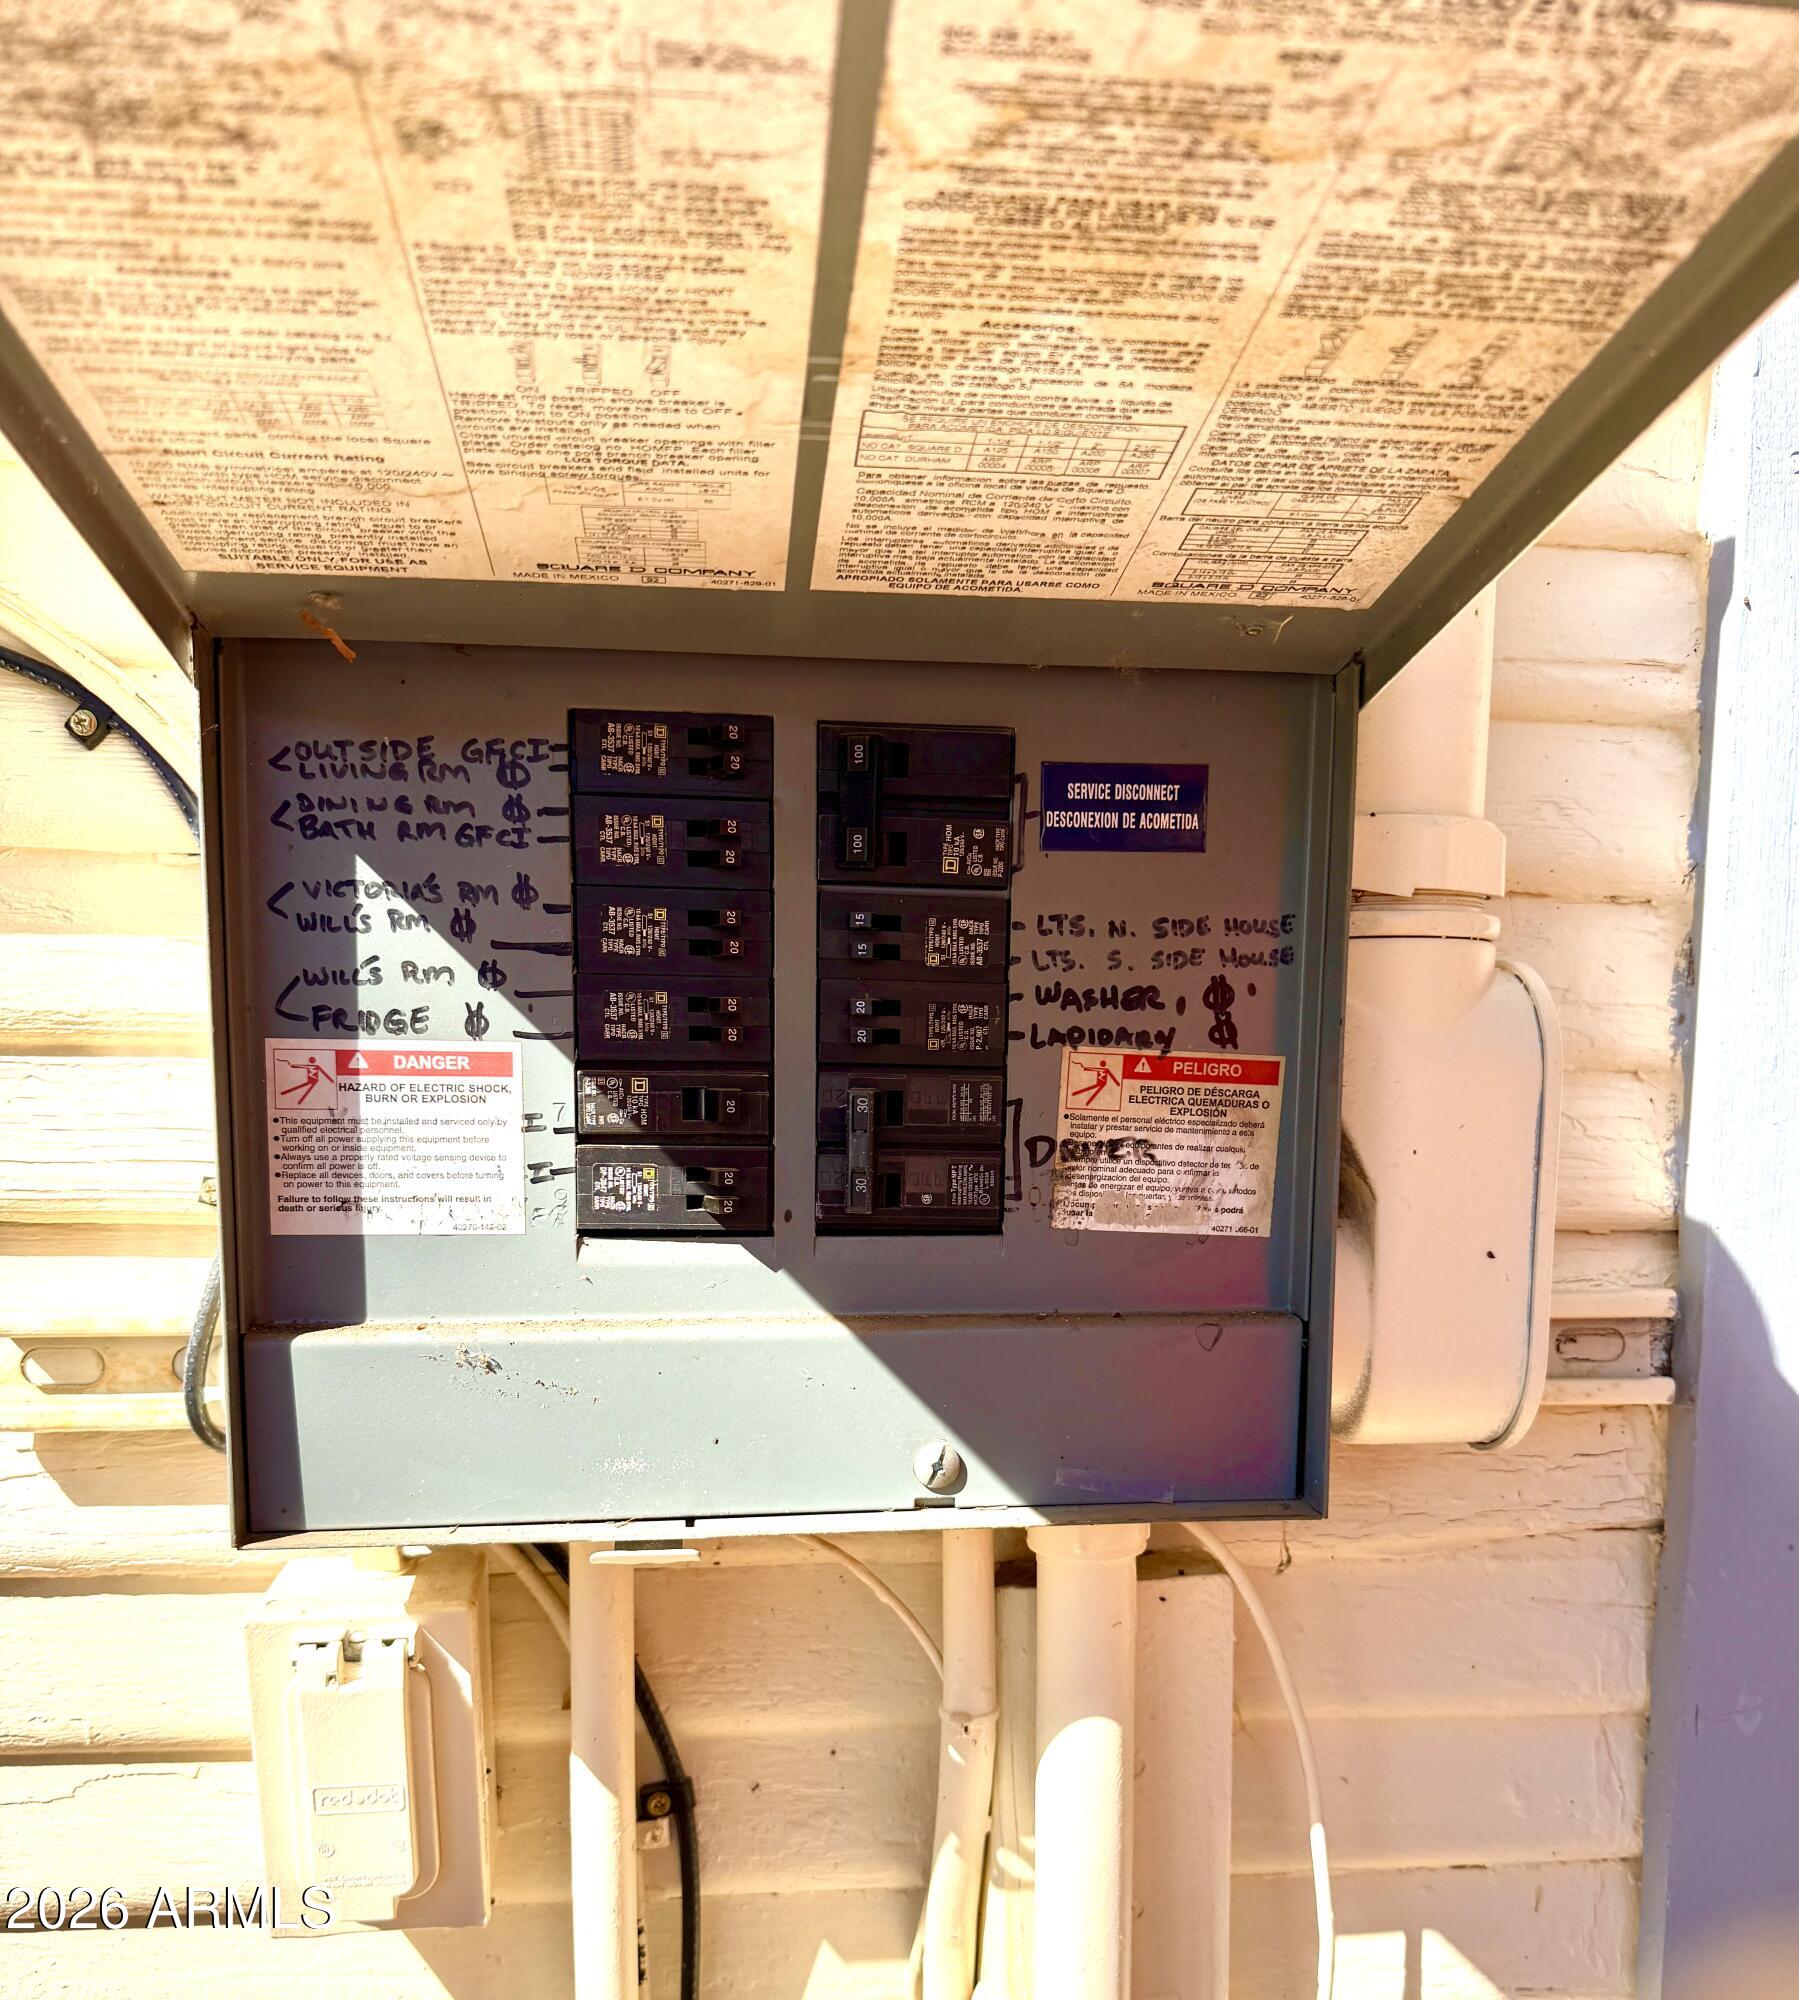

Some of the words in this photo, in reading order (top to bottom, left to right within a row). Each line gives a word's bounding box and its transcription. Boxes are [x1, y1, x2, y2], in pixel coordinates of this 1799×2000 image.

[219, 554, 293, 562] SUITABLE
[325, 565, 408, 573] EQUIPMENT
[655, 568, 756, 576] COMPANY
[953, 585, 1023, 593] ACOMETIDA.
[1152, 582, 1231, 590] SQUARE
[729, 725, 738, 739] 20
[295, 736, 434, 763] OUTSIDE
[462, 738, 549, 765] GFCI
[855, 744, 864, 763] 100
[731, 756, 739, 770] 20
[300, 762, 408, 782] LIVING
[418, 759, 470, 784] RM
[1067, 783, 1112, 800] SERVICE
[1115, 784, 1180, 801] DISCONNECT
[297, 793, 413, 814] DINING
[424, 795, 475, 818] RM
[728, 820, 737, 833] 20
[1046, 810, 1120, 829] DESCONEXION
[1123, 812, 1137, 829] DE
[1140, 812, 1199, 830] ACOMETIDA
[298, 814, 376, 841] BATH
[398, 822, 446, 842] RM
[455, 823, 531, 848] GFCI
[853, 835, 862, 853] 100
[726, 851, 735, 863] 20
[457, 881, 499, 907] RM
[297, 904, 371, 934] WILL'S
[387, 908, 432, 933] RM
[727, 912, 736, 924] 20
[855, 913, 864, 926] 15
[1152, 915, 1211, 939] SIDE
[1224, 914, 1295, 938] HOUSE
[730, 941, 738, 954] 20
[858, 943, 867, 956] 15
[1151, 948, 1205, 970] SIDE
[1219, 946, 1295, 969] HOUSE
[303, 955, 383, 986] WILL'S
[401, 961, 455, 986] RM
[728, 999, 737, 1011] 20
[856, 1001, 865, 1013] 20
[312, 1005, 429, 1035] FRIDGE
[728, 1029, 737, 1041] 20
[857, 1030, 866, 1043] 20
[394, 1055, 471, 1070] DANGER
[1173, 1062, 1242, 1077] PELIGRO
[339, 1083, 387, 1092] HAZARD
[391, 1084, 405, 1092] OF
[409, 1084, 465, 1092] ELECTRIC
[469, 1084, 512, 1094] SHOCK,
[1140, 1086, 1184, 1095] PELIGRO
[1187, 1087, 1201, 1095] DE
[365, 1094, 398, 1103] BURN
[401, 1094, 418, 1103] OR
[422, 1095, 487, 1104] EXPLOSION
[857, 1098, 867, 1113] 30
[1129, 1095, 1185, 1106] ELECTRICA
[1188, 1098, 1259, 1109] QUEMADURAS
[1262, 1101, 1270, 1109] O
[726, 1101, 735, 1113] 20
[1170, 1106, 1227, 1117] EXPLOSIÓN
[301, 1117, 345, 1126] equipment
[384, 1117, 419, 1125] installed
[1070, 1113, 1109, 1122] Solamente
[1111, 1114, 1119, 1122] el
[1121, 1116, 1152, 1124] personal
[282, 1126, 317, 1135] qualified
[320, 1126, 357, 1134] electrical
[1106, 1124, 1132, 1132] prestar
[1134, 1124, 1162, 1133] servicio
[303, 1135, 313, 1143] off
[328, 1137, 354, 1145] power
[357, 1136, 397, 1145] supplying
[417, 1136, 460, 1145] equipment
[282, 1144, 315, 1153] working
[725, 1173, 733, 1184] 20
[856, 1179, 866, 1192] 30
[381, 1195, 435, 1203] instructions
[724, 1200, 732, 1212] 20
